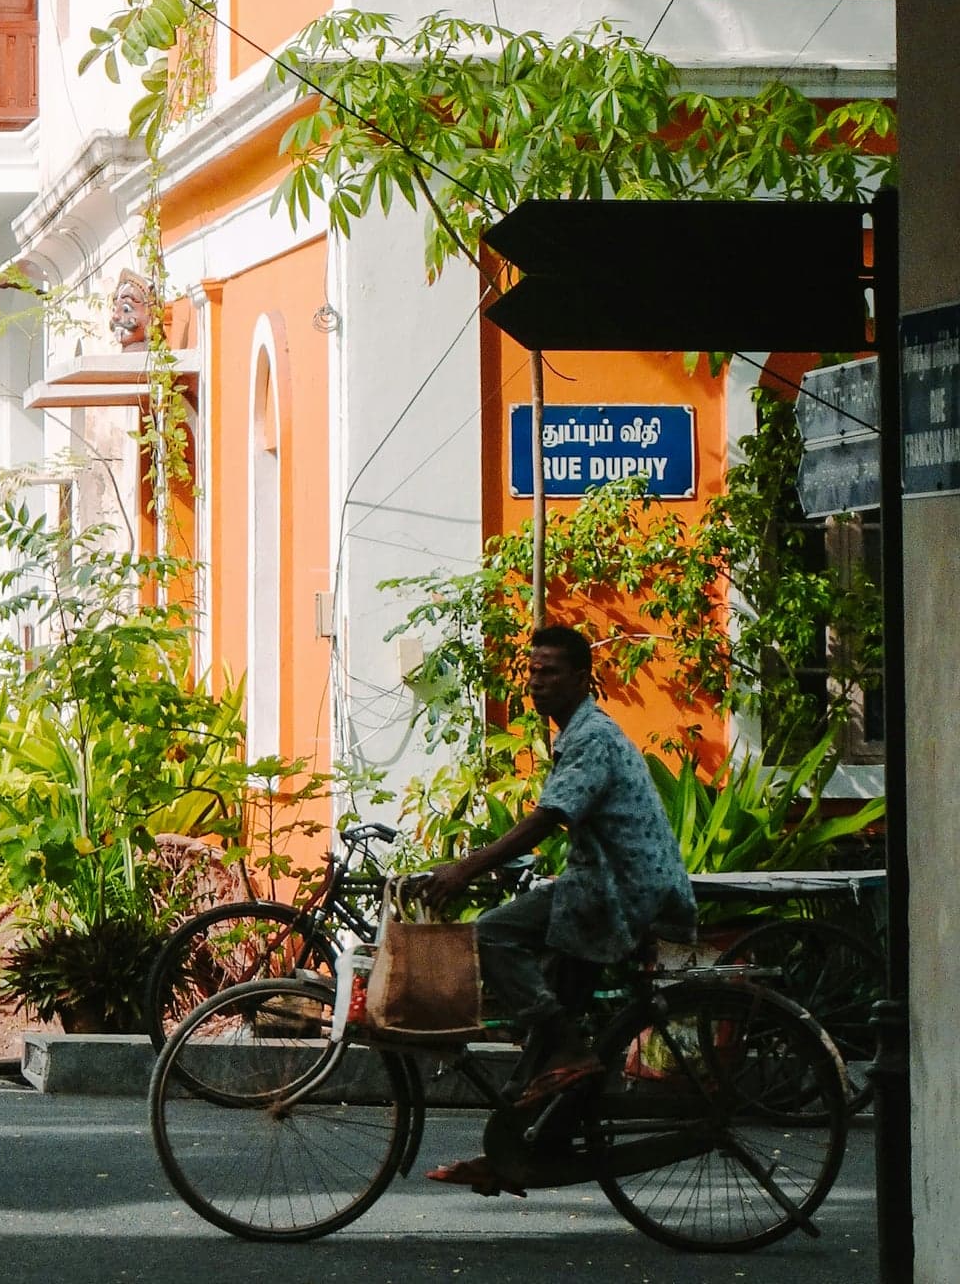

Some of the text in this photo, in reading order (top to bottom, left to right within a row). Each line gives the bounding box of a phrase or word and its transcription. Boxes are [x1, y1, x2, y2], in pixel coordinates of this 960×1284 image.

[620, 417, 661, 449] வீதி
[543, 457, 668, 480] RUE DUPUY
